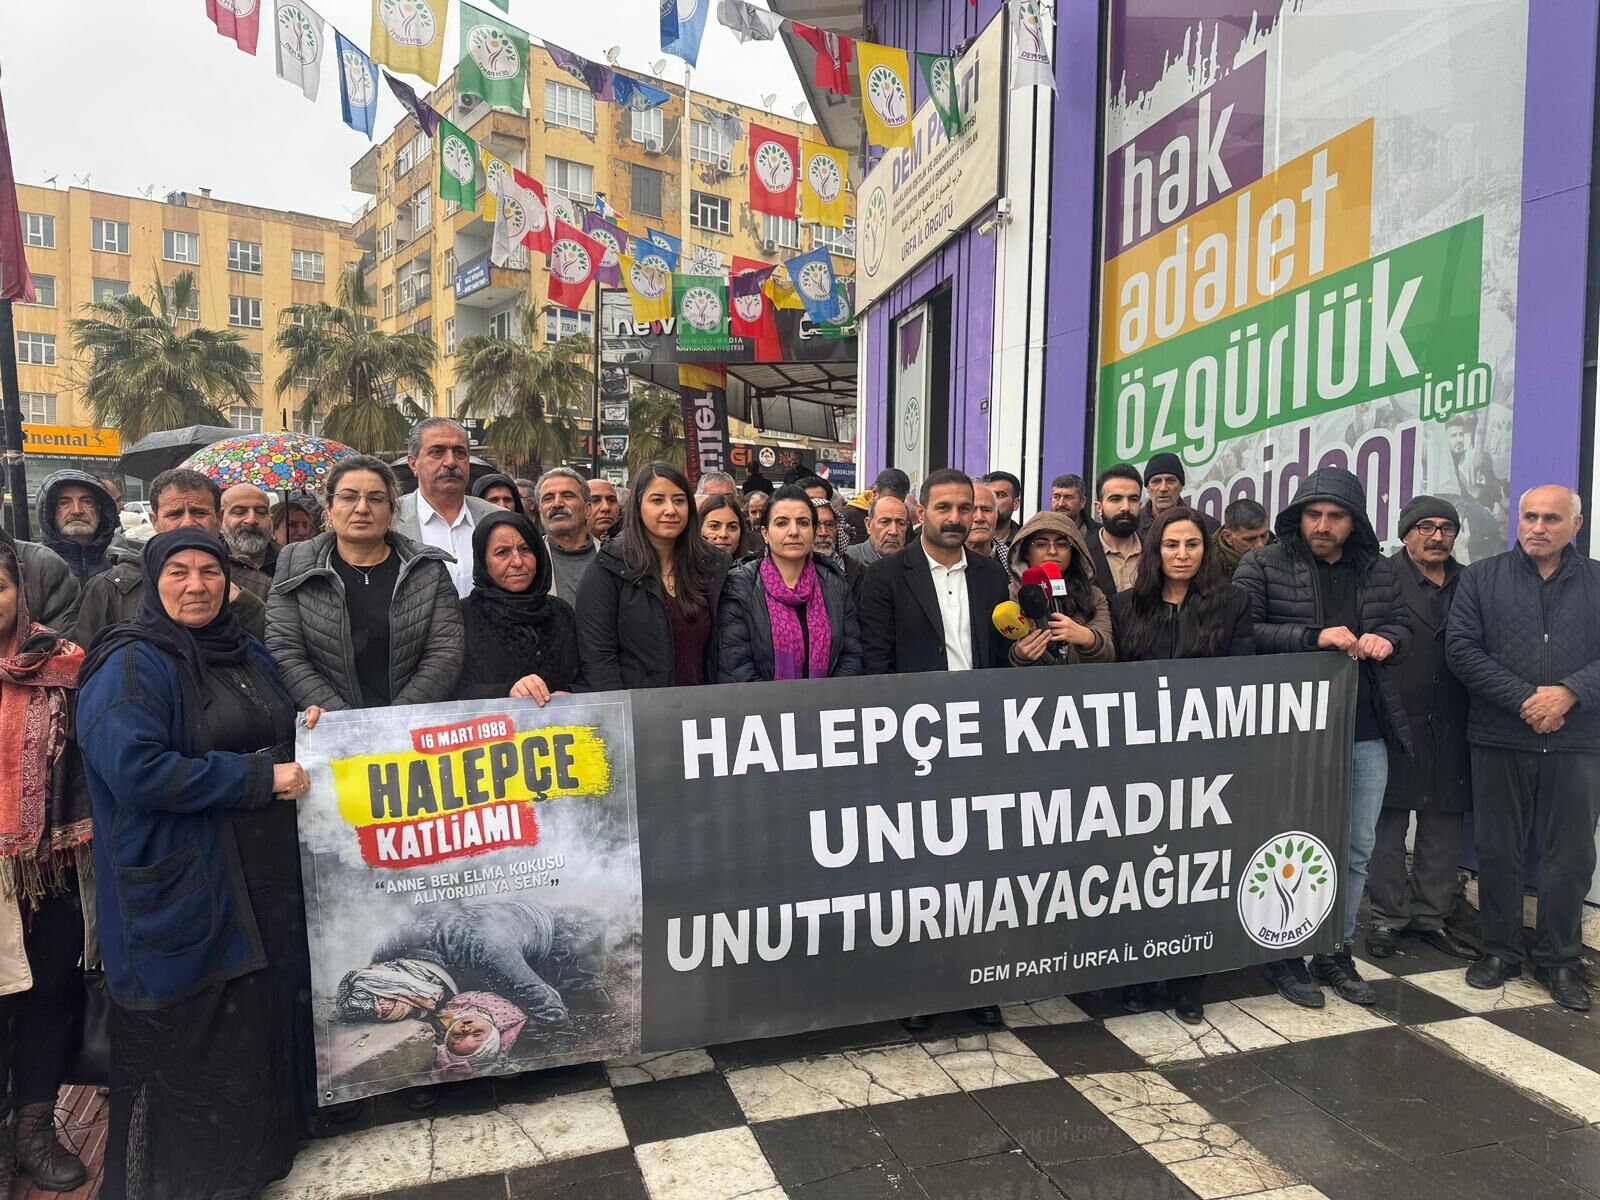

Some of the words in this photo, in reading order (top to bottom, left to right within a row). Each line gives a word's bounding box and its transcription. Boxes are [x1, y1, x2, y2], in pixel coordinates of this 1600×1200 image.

[928, 48, 980, 156] PTİ
[1122, 91, 1236, 248] hak
[901, 234, 917, 262] URFA
[924, 195, 953, 241] ÖRGÜTÜ
[1119, 147, 1339, 354] adalet
[561, 322, 577, 333] FIRAT
[1116, 258, 1424, 464] özgürlük
[1422, 363, 1489, 419] için
[23, 429, 89, 447] inental
[421, 733, 434, 749] 16
[437, 726, 474, 748] MART
[478, 721, 507, 740] 1988
[681, 701, 983, 780] HALEPÇE
[1003, 676, 1330, 755] KATLİAMINI
[367, 733, 580, 819] HALEPÇE
[375, 803, 522, 861] KATLİAMI
[809, 773, 1235, 869] UNUTMADIK
[431, 872, 460, 888] BEN
[464, 868, 505, 884] ELMA
[509, 854, 566, 876] KOKUSU
[492, 879, 510, 893] YA
[667, 843, 1232, 972] UNUTTURMAYACAĞIZ!
[1257, 926, 1280, 943] DEM
[1280, 916, 1314, 942] PARTİ
[969, 964, 1010, 984] DEM
[1015, 951, 1067, 978] PARTİ
[1072, 948, 1120, 970] URFA
[1123, 945, 1139, 963] İL
[1145, 930, 1215, 959] ÖRGÜTÜ
